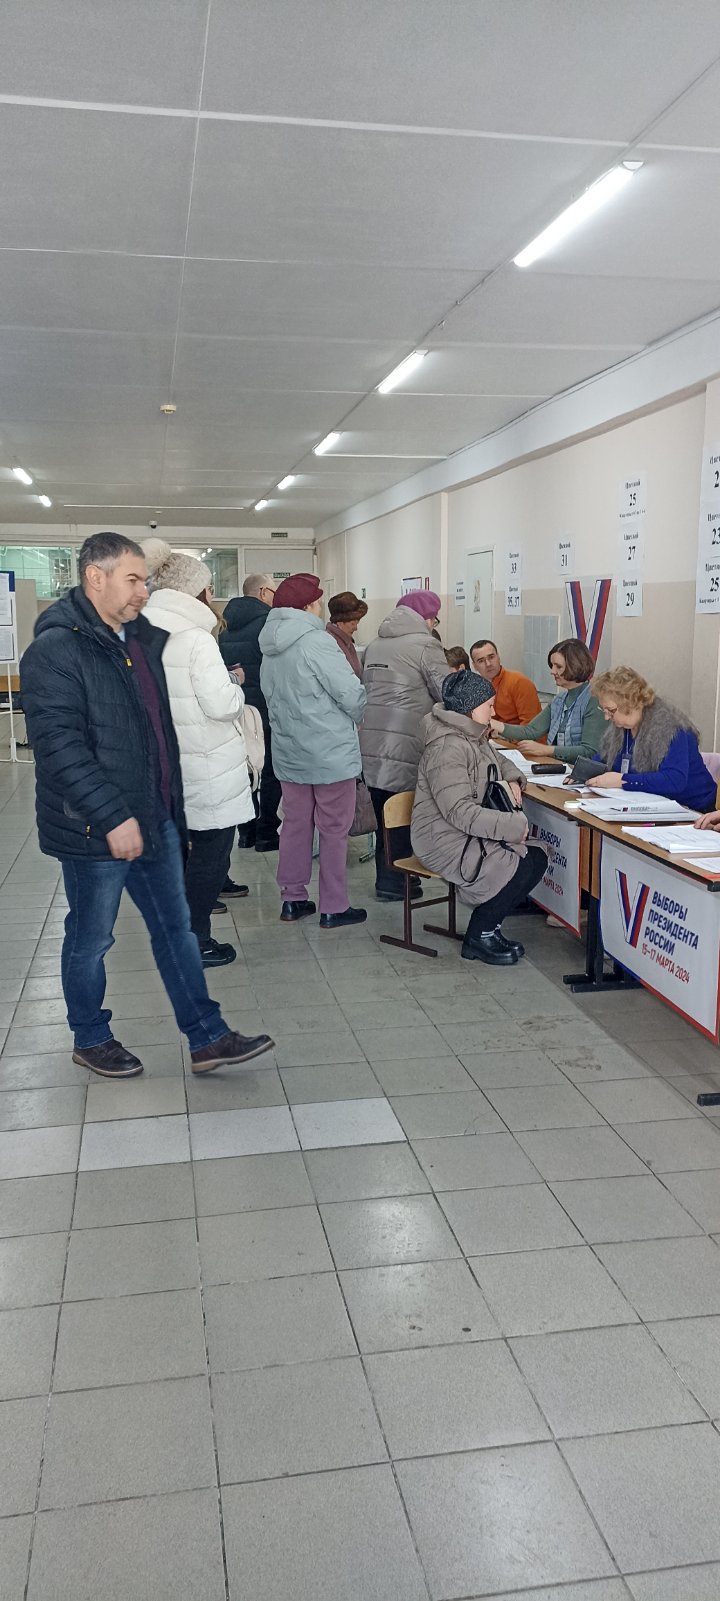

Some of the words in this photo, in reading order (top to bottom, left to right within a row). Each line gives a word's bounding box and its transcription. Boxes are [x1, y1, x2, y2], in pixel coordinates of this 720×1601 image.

[629, 492, 637, 506] 25
[561, 554, 568, 567] 31
[627, 545, 636, 561] 27
[709, 576, 720, 592] 25
[625, 592, 635, 607] 29
[540, 828, 562, 848] ВЫБОРЫ
[651, 890, 689, 921] ВЫБОРЫ
[647, 908, 699, 950] ПРЕЗИДЕНТА
[644, 926, 676, 956] РОССИИ
[656, 952, 675, 975] МАРТА
[675, 964, 690, 984] 2024
